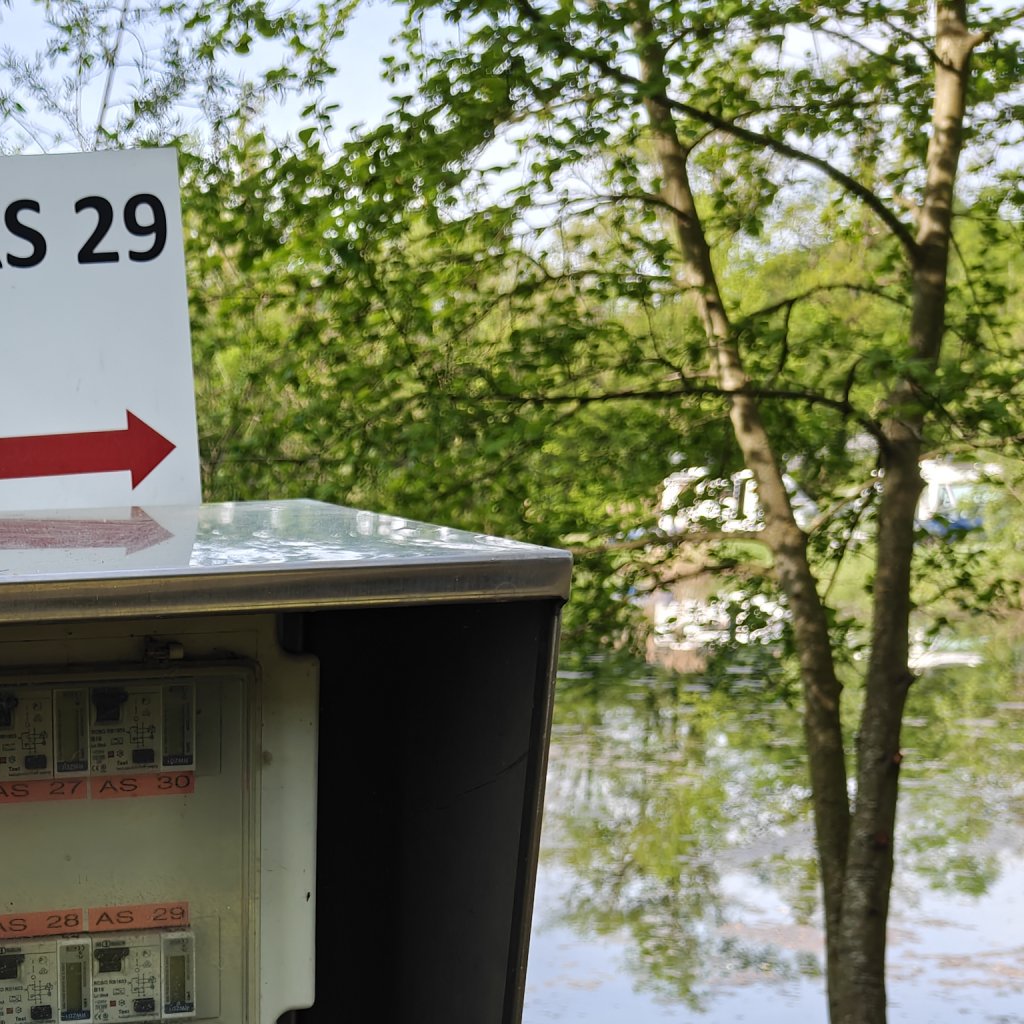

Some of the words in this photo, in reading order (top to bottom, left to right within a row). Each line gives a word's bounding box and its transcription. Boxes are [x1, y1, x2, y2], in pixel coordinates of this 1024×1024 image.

[73, 193, 168, 265] 29
[49, 780, 82, 795] 27
[99, 778, 138, 793] AS
[157, 774, 190, 790] 30
[46, 914, 79, 929] 28
[95, 910, 134, 926] AS
[152, 906, 185, 921] 29
